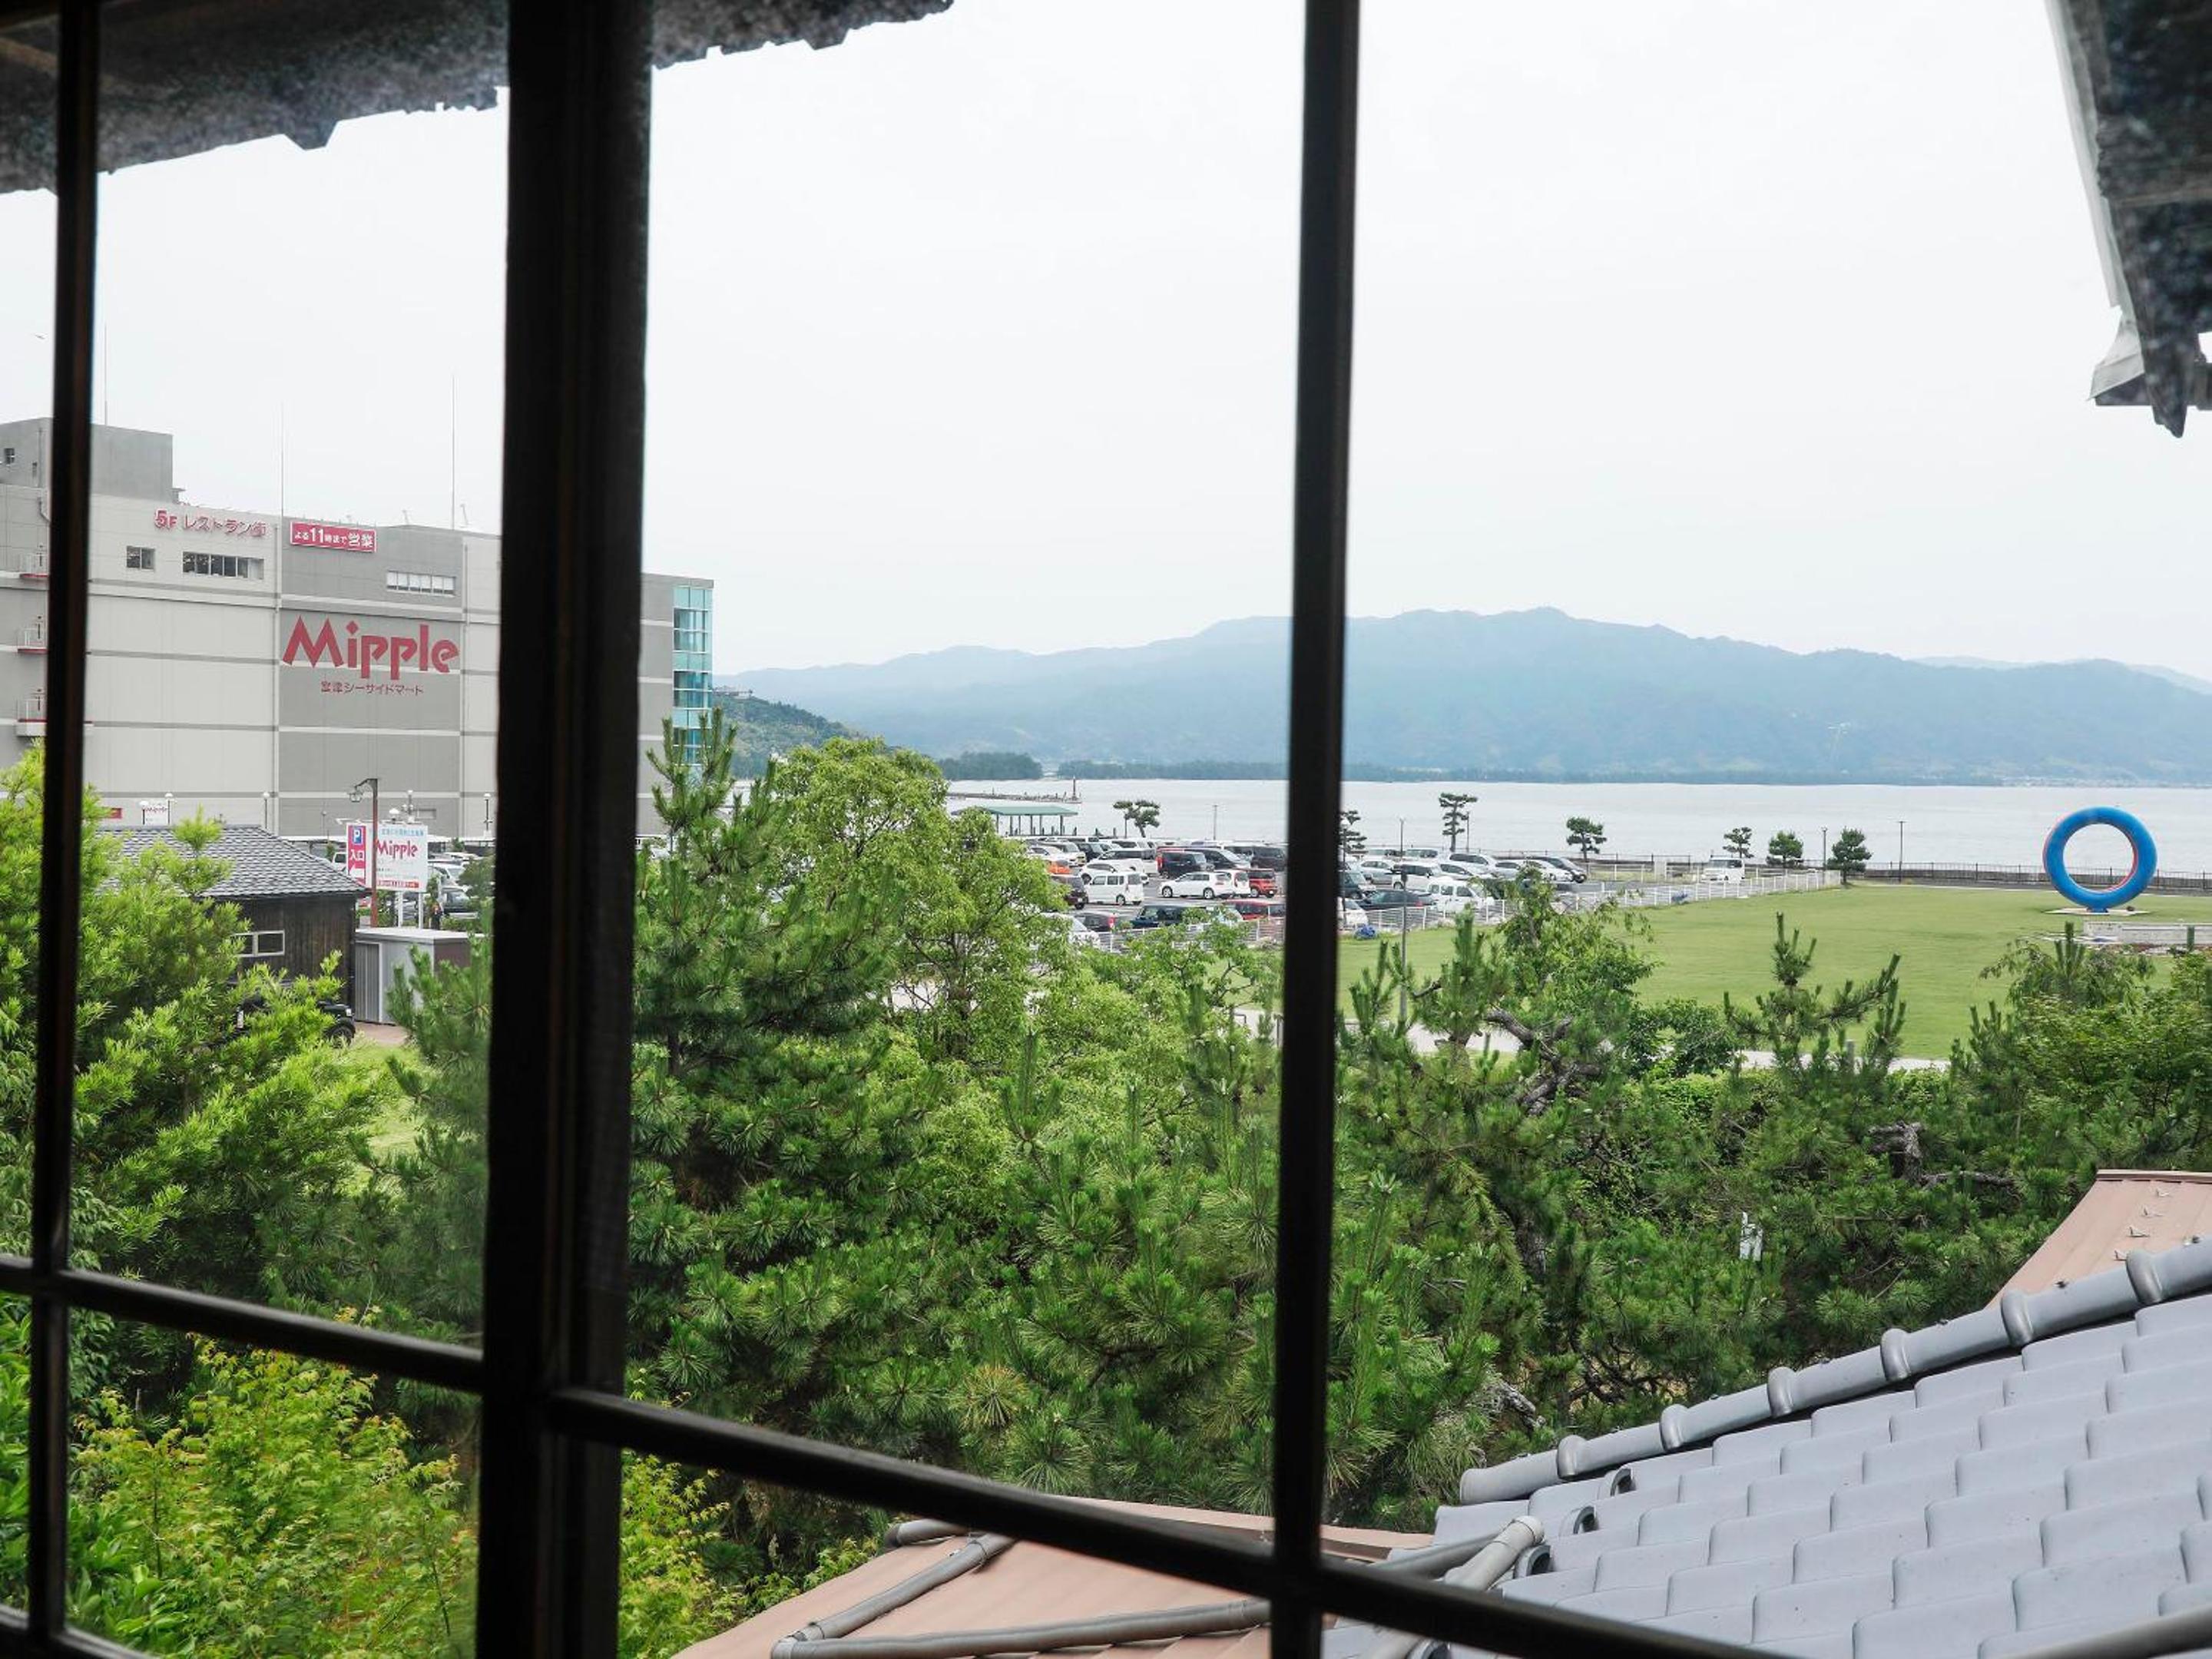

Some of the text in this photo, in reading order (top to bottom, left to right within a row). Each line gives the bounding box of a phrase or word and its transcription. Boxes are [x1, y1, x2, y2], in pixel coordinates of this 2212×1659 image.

[154, 510, 177, 528] 5F
[282, 615, 459, 680] Mipple
[349, 849, 364, 861] 入口
[376, 840, 418, 859] Mipple
